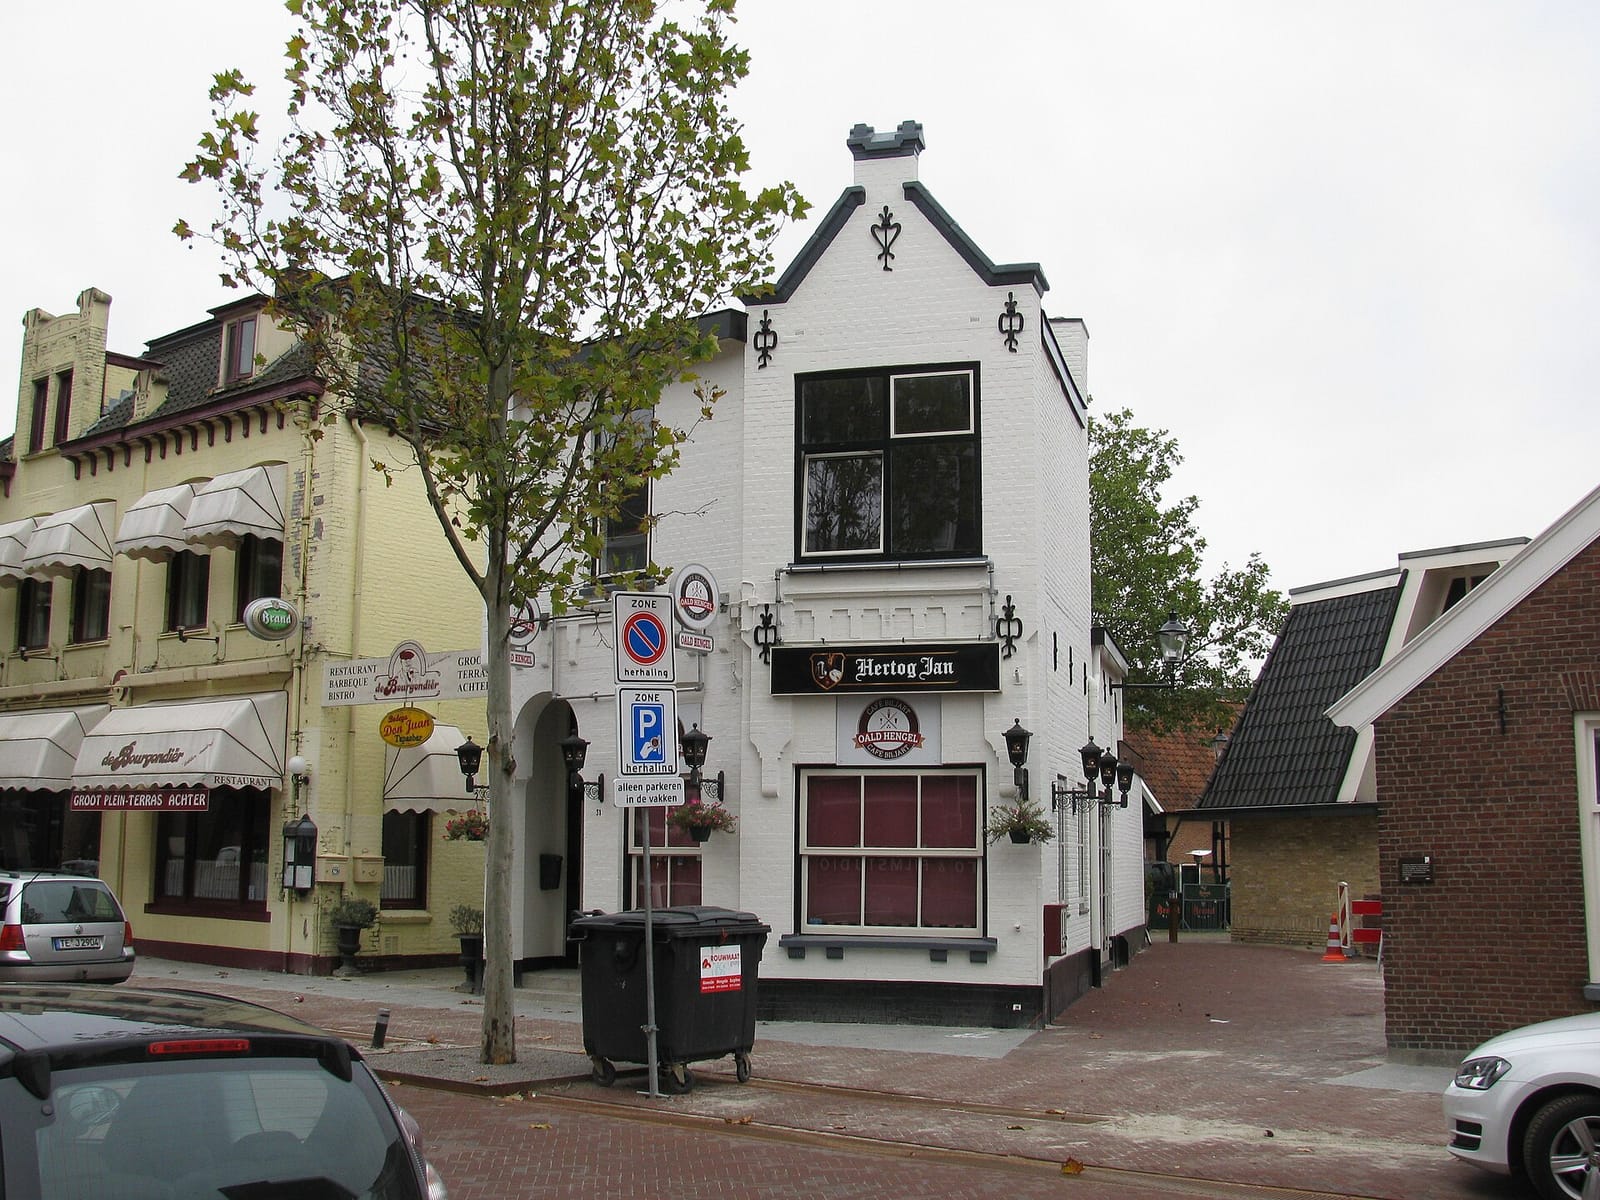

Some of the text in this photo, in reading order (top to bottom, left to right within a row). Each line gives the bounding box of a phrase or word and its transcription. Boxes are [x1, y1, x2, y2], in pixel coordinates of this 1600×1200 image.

[631, 600, 657, 608] ZONE
[680, 598, 713, 611] OALD HENGEL
[262, 610, 291, 625] Brand
[680, 635, 711, 649] OALD HENGEL
[457, 656, 481, 667] GROO
[329, 665, 377, 676] RESTAURANT
[624, 668, 668, 678] herhaling
[855, 656, 955, 682] Hertog Jan
[329, 678, 368, 688] BARBEQUE
[328, 691, 355, 700] BISTRO
[634, 694, 660, 702] ZONE
[383, 719, 430, 737] Don Juan
[639, 709, 657, 738] P
[858, 731, 918, 743] OALD HENGEL
[101, 750, 113, 767] de
[110, 740, 184, 771] Bourgondiër
[626, 762, 673, 774] herhaling
[214, 776, 273, 787] RESTAURANT
[617, 781, 682, 793] alleen parkeren
[73, 793, 206, 807] GROOT PLEIN-TERRAS ACHTER
[626, 793, 677, 803] in de vakken
